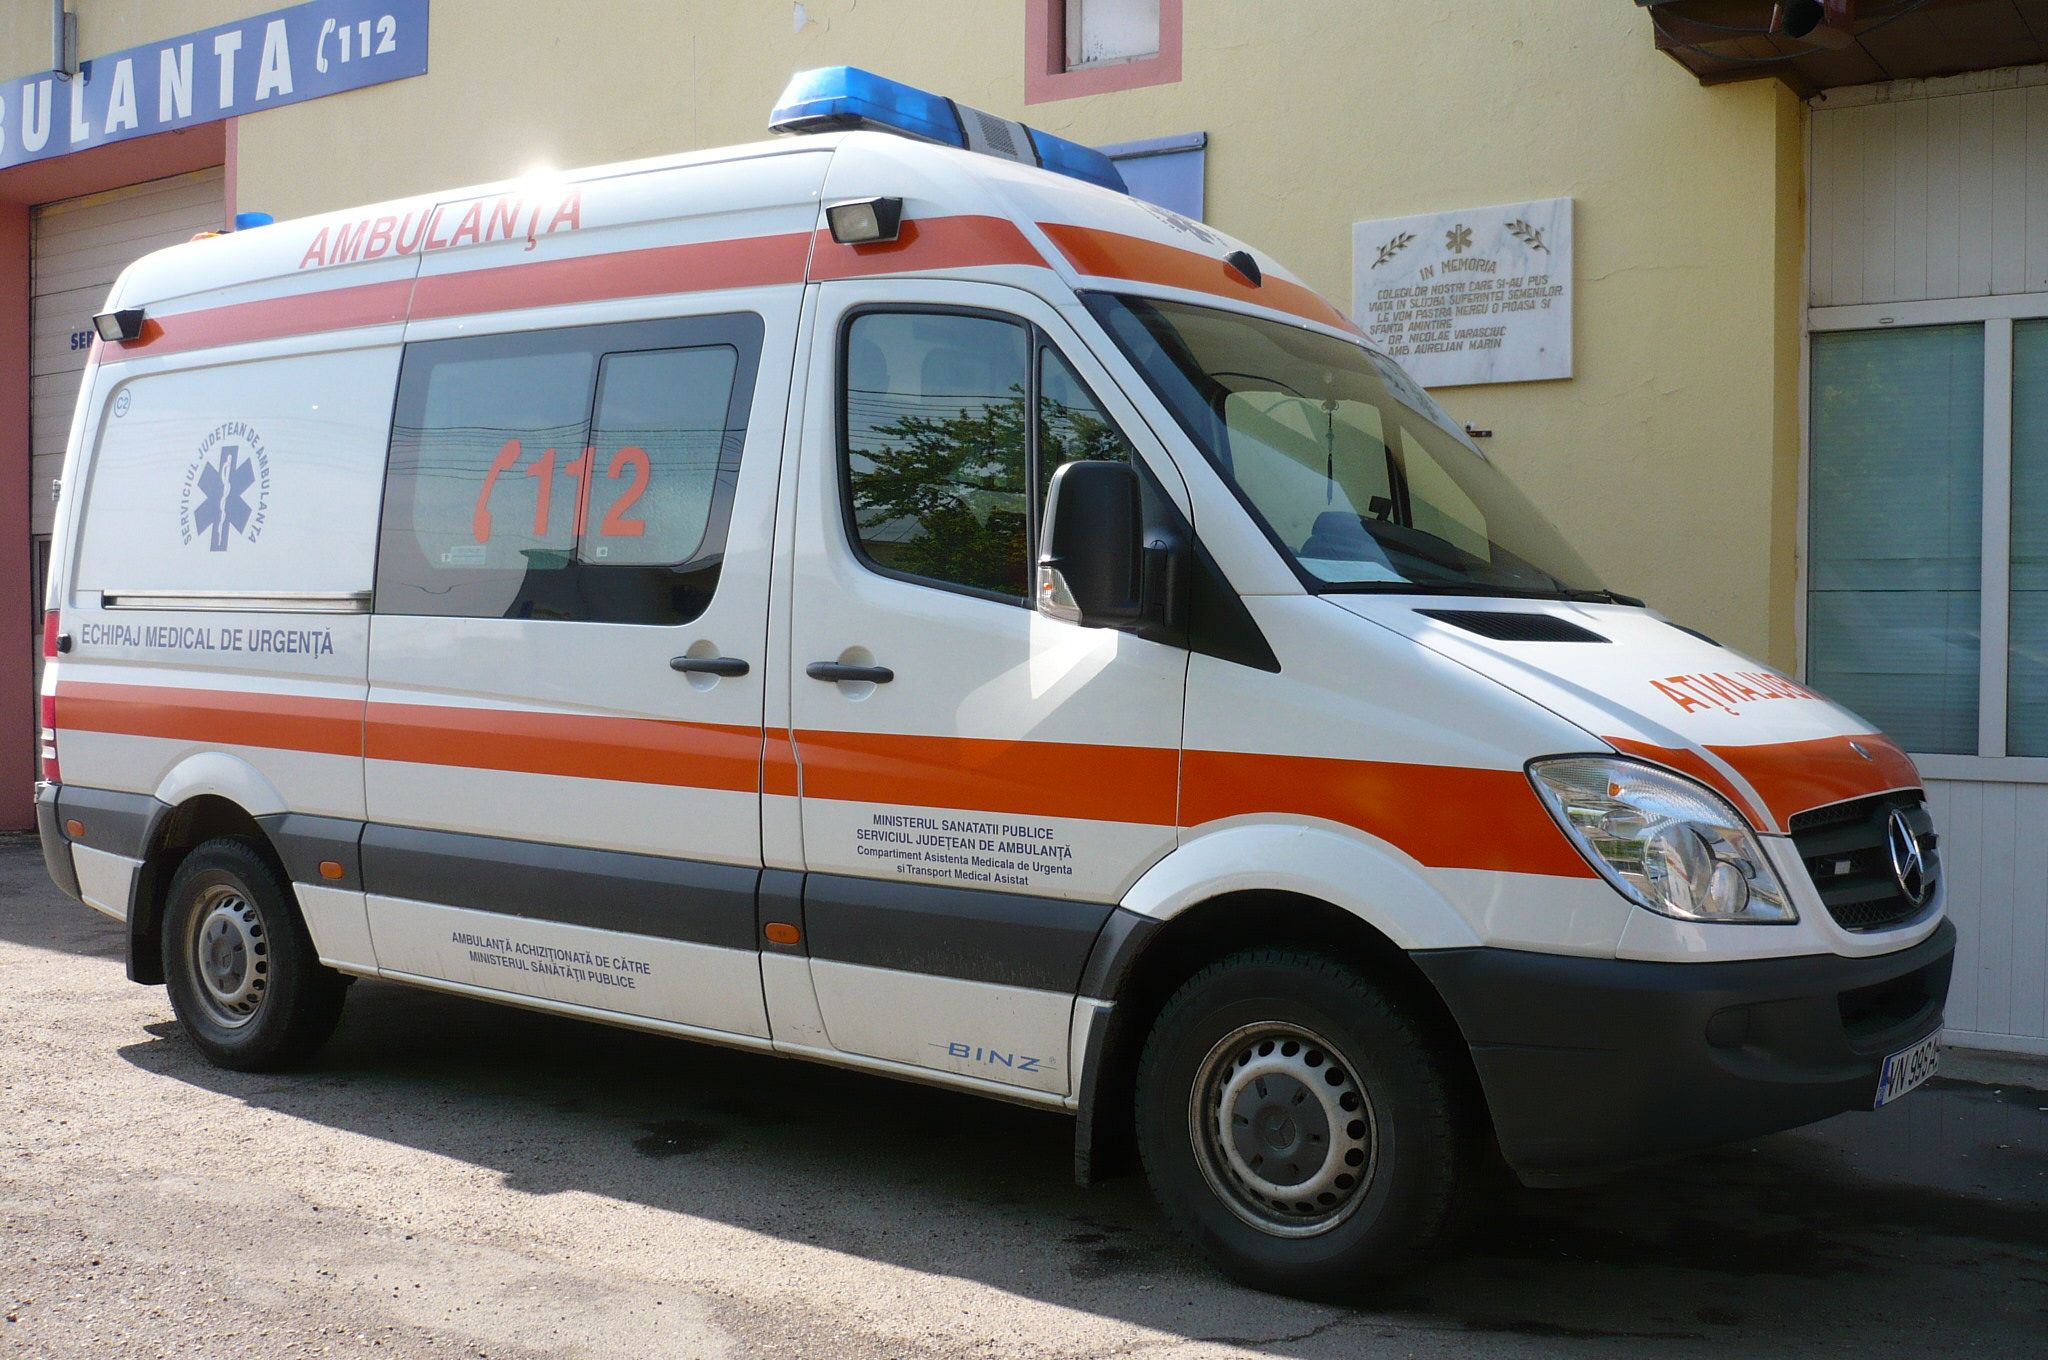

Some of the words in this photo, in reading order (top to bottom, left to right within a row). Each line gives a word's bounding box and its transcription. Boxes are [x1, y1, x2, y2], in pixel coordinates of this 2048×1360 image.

[0, 20, 294, 155] ULANTA
[339, 15, 396, 63] 112
[1419, 265, 1434, 281] IN
[1441, 259, 1497, 274] MEMORIA
[1431, 282, 1466, 295] NOSTRI
[1469, 280, 1493, 291] CARE
[1528, 275, 1549, 286] PUS
[1369, 301, 1393, 312] VIATA
[1397, 300, 1406, 310] IN
[1378, 312, 1389, 323] LE
[1393, 310, 1412, 321] VOM
[1416, 307, 1452, 320] PASTRA
[1455, 304, 1488, 316] MEREU
[1492, 303, 1499, 314] O
[1502, 301, 1535, 313] PIOASA
[1541, 299, 1551, 309] SI
[1370, 323, 1403, 335] SFANTA
[1408, 318, 1453, 332] AMINTIRE
[1409, 331, 1450, 343] NICOLAE
[1414, 341, 1463, 354] AURELIAN
[1469, 338, 1502, 349] MARIN
[180, 463, 199, 546] SERVICIUL
[247, 428, 260, 449] DE
[527, 445, 650, 536] 112
[81, 623, 141, 646] ECHIPAJ
[145, 626, 215, 650] MEDICAL
[221, 628, 243, 651] DE
[873, 814, 939, 830] MINISTERUL
[941, 819, 999, 835] SANATATII
[1002, 825, 1054, 840] PUBLICE
[857, 829, 913, 844] SERVICIUL
[979, 840, 995, 851] DE
[857, 845, 922, 860] Compartiment
[924, 851, 969, 865] Asistenta
[971, 856, 1015, 870] Medicala
[1017, 859, 1030, 871] de
[1032, 861, 1073, 875] Urgenta
[897, 864, 905, 873] si
[907, 864, 952, 878] Transport
[954, 869, 991, 881] Medical
[994, 874, 1029, 886] Asistat
[469, 951, 529, 971] MINISTERUL
[588, 971, 636, 988] PUBLICE
[595, 956, 611, 968] DE
[613, 956, 651, 975] CĂTRE
[948, 1042, 1040, 1072] BINZ
[1887, 1054, 1909, 1097] VN
